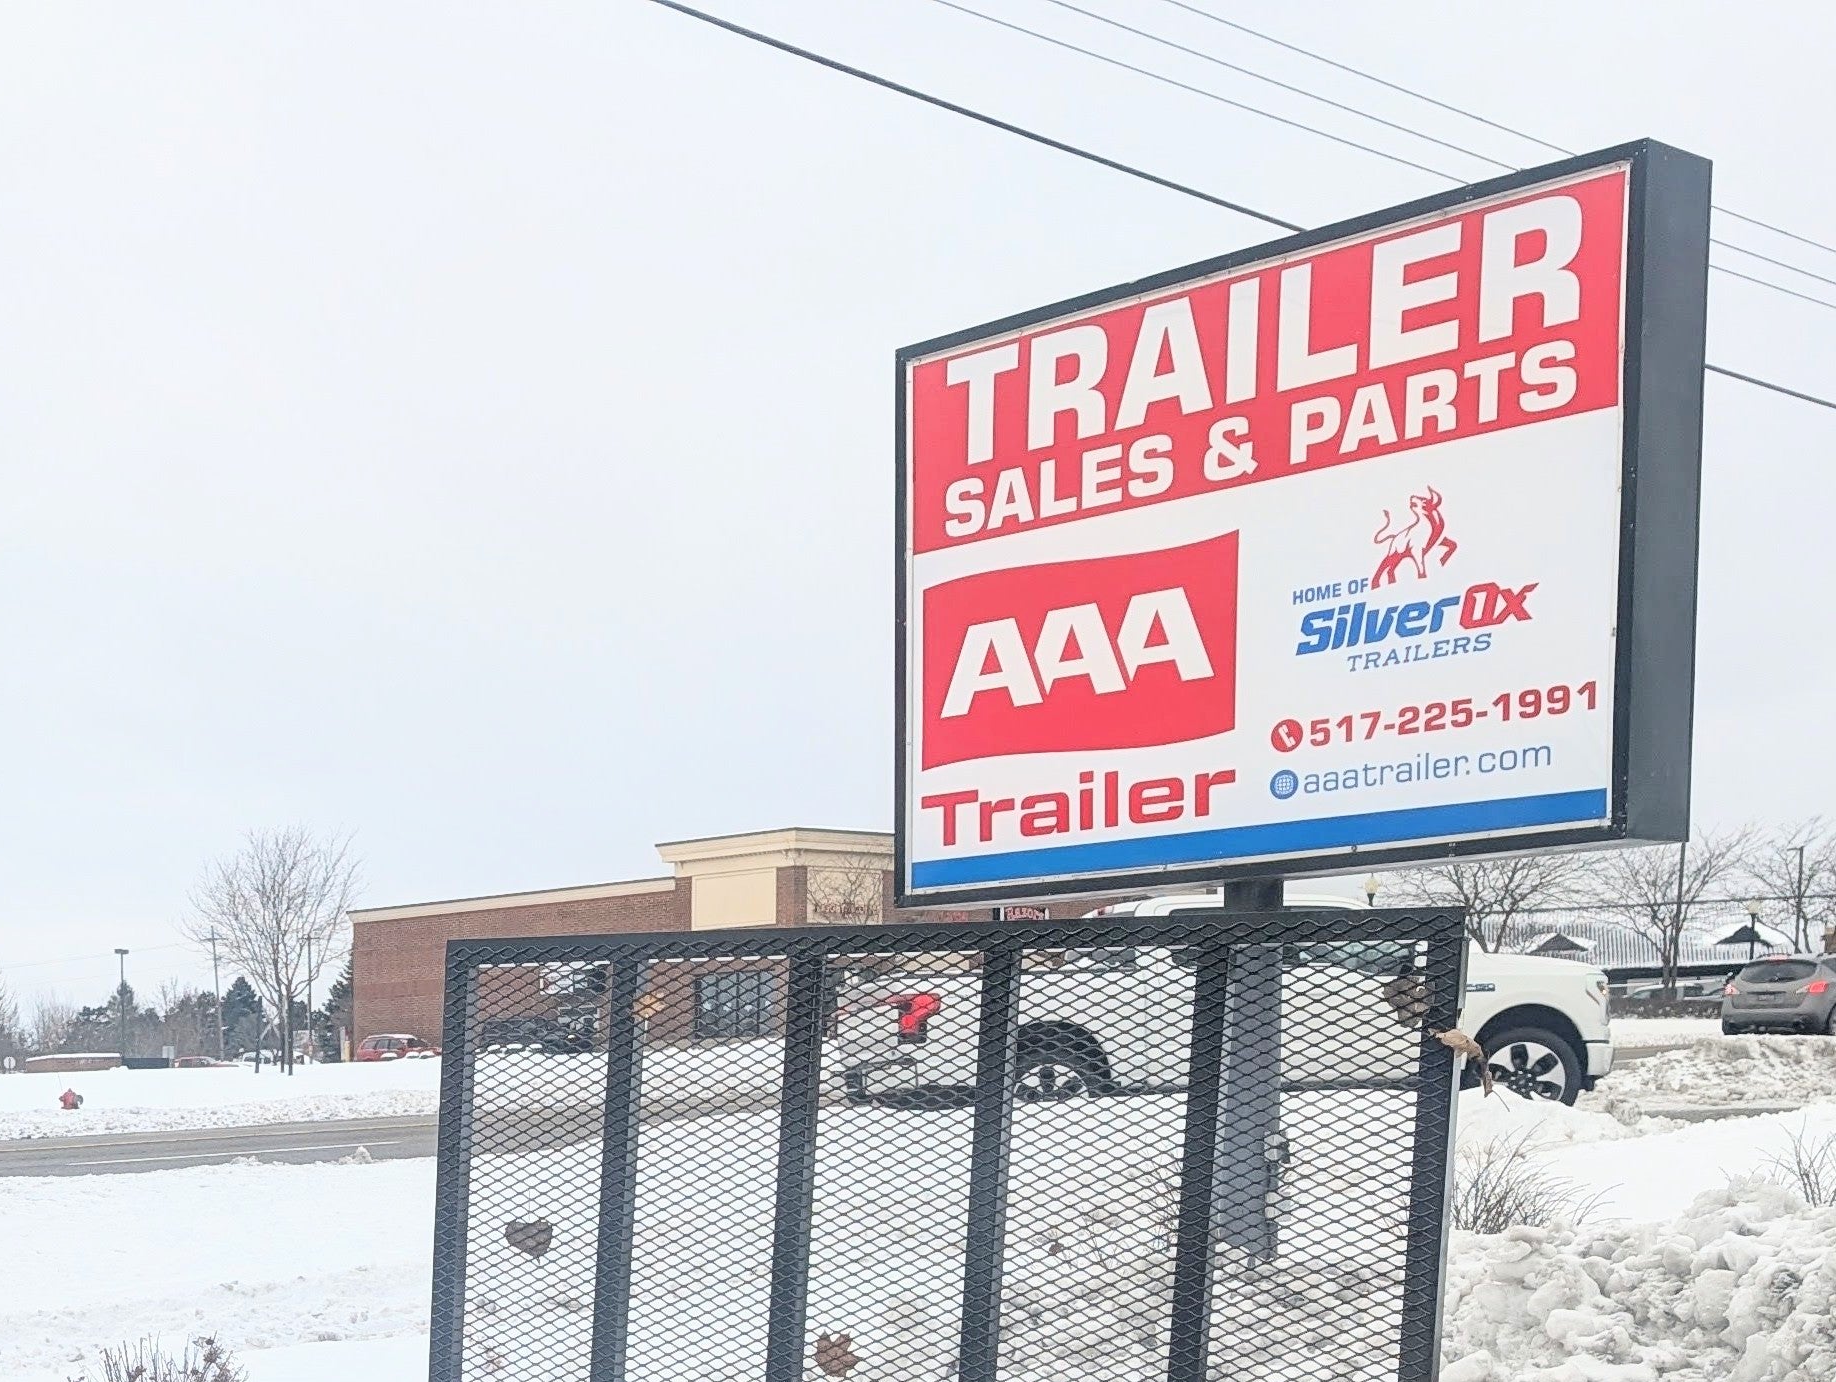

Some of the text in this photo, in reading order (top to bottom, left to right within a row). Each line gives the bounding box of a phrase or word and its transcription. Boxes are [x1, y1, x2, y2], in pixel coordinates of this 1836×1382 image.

[945, 194, 1584, 465] TRAILER
[944, 340, 1577, 538] SALES & PARTS
[1292, 577, 1369, 605] HOME OF
[940, 586, 1215, 720] AAA
[1347, 633, 1493, 673] TRAILERS
[1310, 680, 1597, 748] 517-225-1991
[1303, 745, 1552, 795] aaatrailer.com
[921, 768, 1236, 847] Trailer
